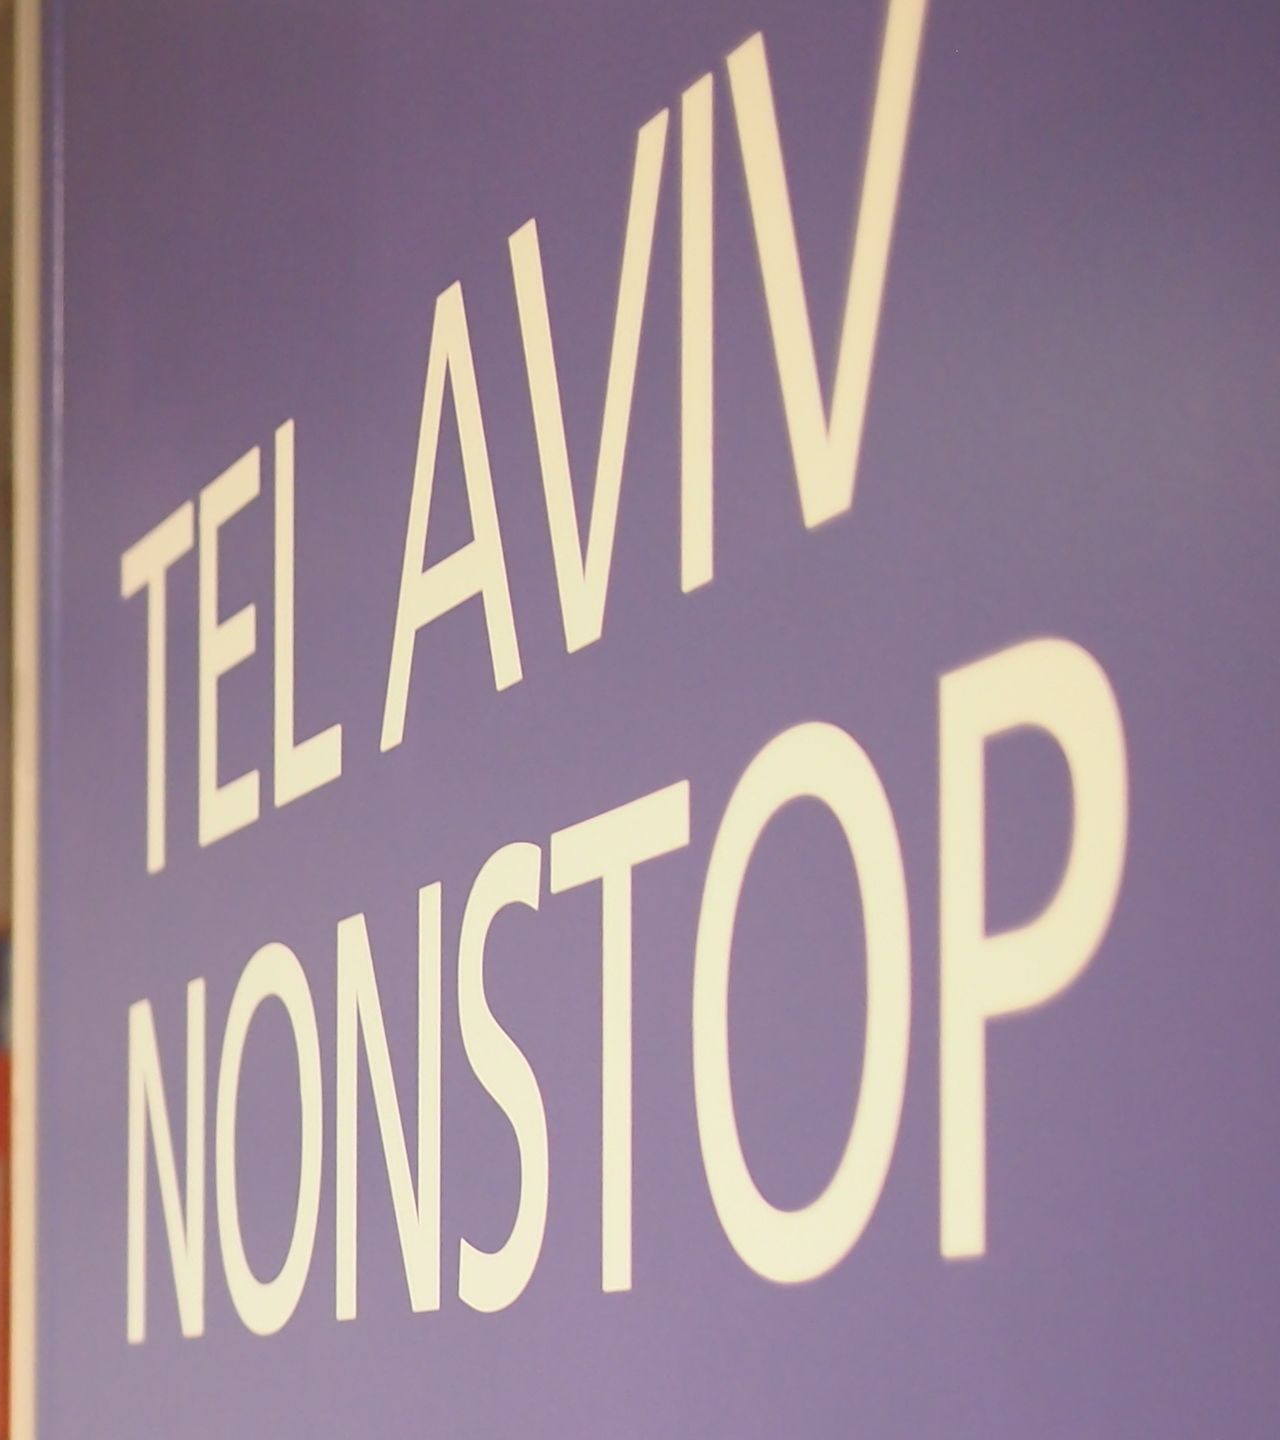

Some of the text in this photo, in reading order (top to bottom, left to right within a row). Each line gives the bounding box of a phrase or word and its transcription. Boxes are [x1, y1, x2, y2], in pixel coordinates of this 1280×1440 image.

[121, 0, 930, 875] TEL AVIV
[126, 637, 1129, 1345] NONSTOP
